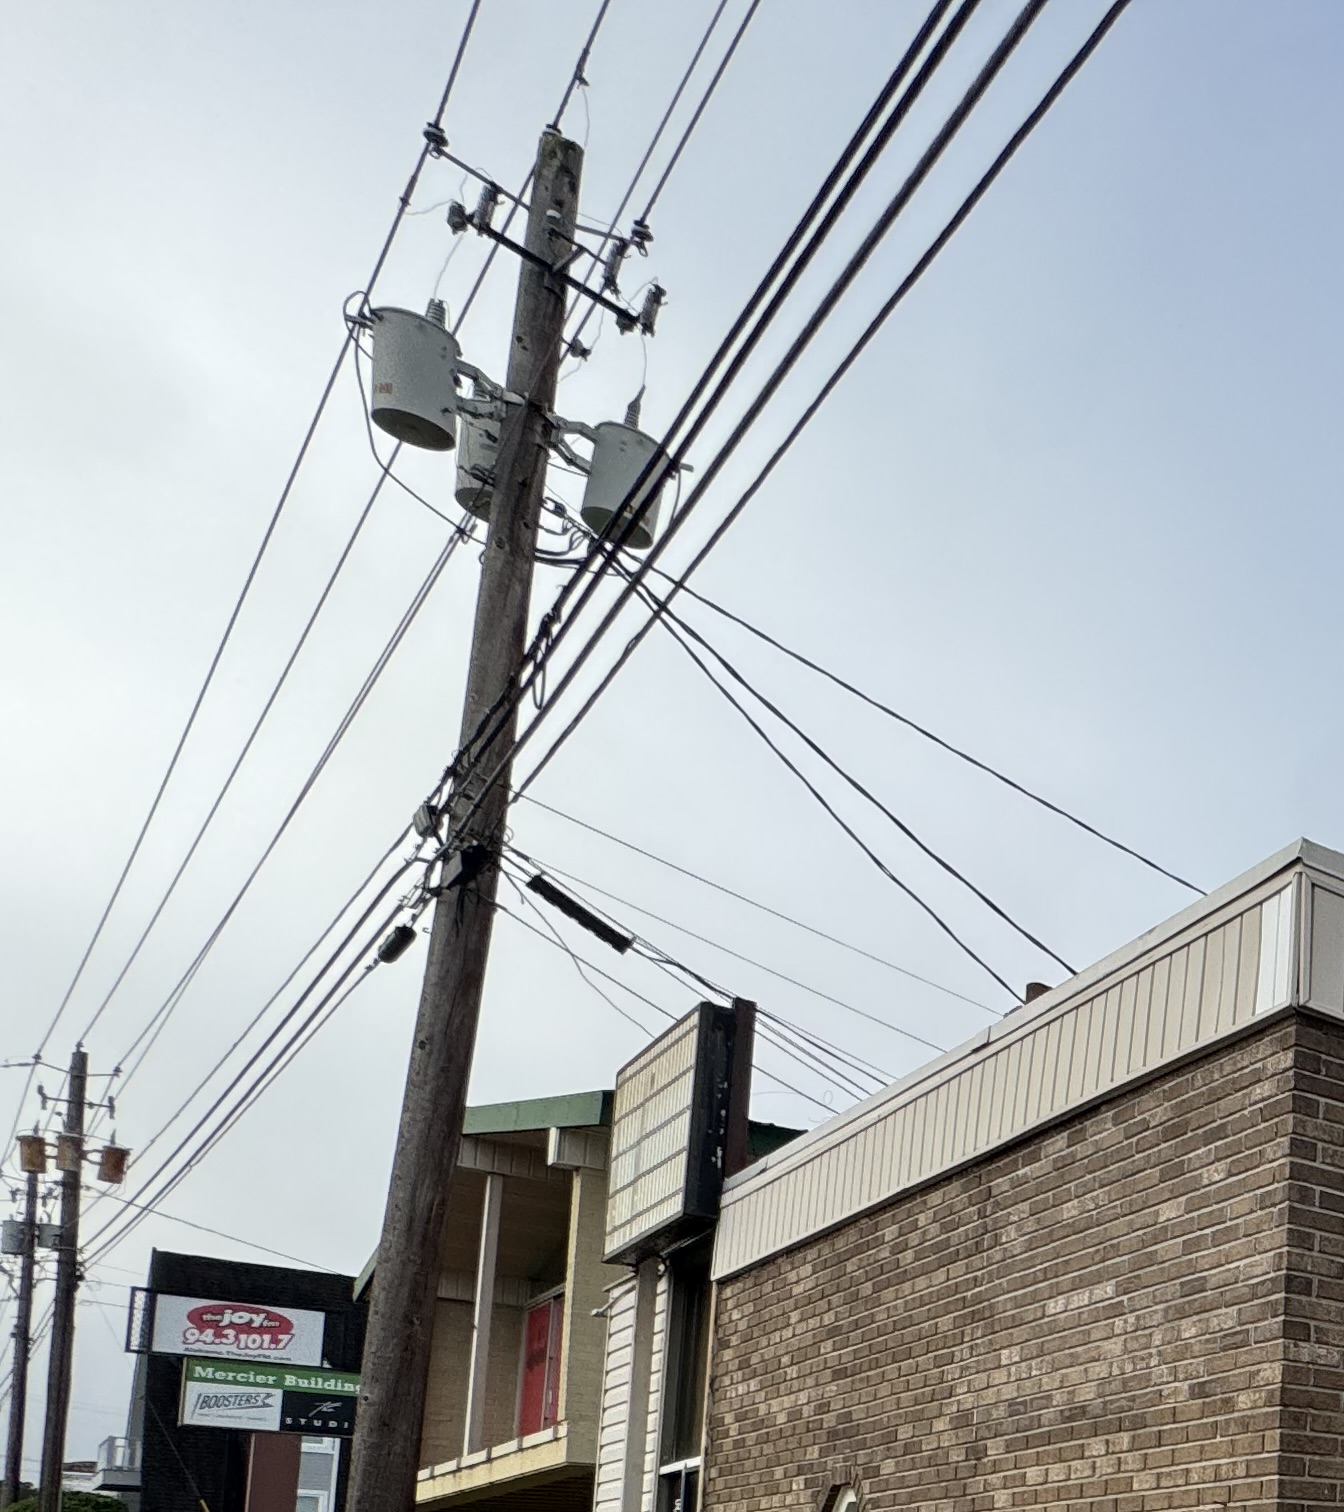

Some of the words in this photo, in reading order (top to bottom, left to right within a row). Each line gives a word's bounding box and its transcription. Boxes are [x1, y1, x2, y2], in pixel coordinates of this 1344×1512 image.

[219, 1309, 267, 1328] joy
[183, 1327, 237, 1345] 94.3
[237, 1333, 295, 1350] 101.7
[193, 1366, 277, 1385] Mercier
[199, 1394, 261, 1410] BOOSTERS
[285, 1417, 349, 1429] STUDI
